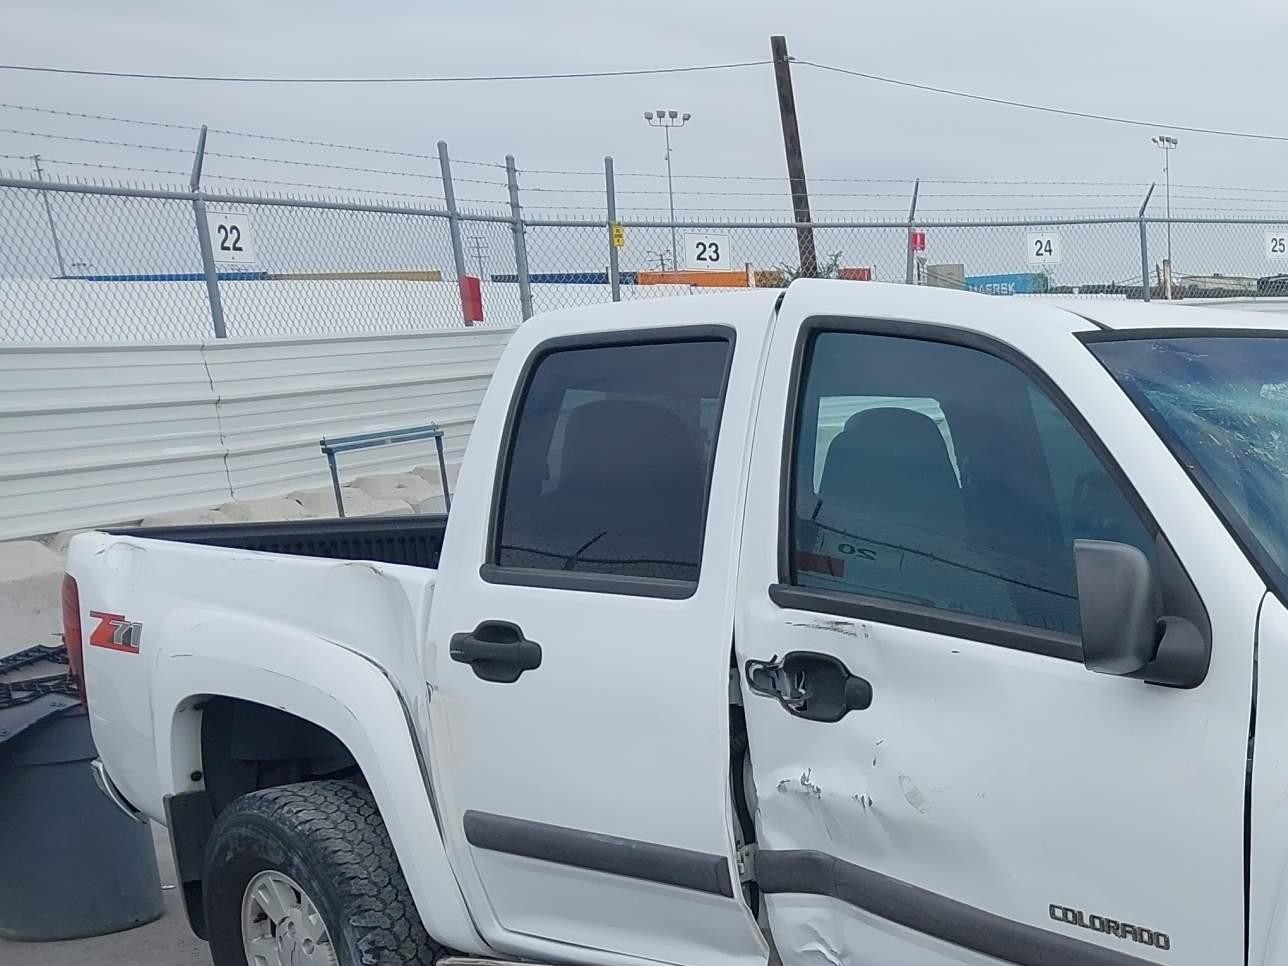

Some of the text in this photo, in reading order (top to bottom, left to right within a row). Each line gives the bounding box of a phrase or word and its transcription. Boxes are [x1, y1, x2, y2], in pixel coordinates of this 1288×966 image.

[216, 223, 243, 252] 22
[1034, 239, 1053, 257] 24
[1270, 237, 1286, 253] 25
[694, 240, 721, 263] 23
[89, 610, 144, 654] Z71
[1048, 903, 1171, 951] COLORADO
